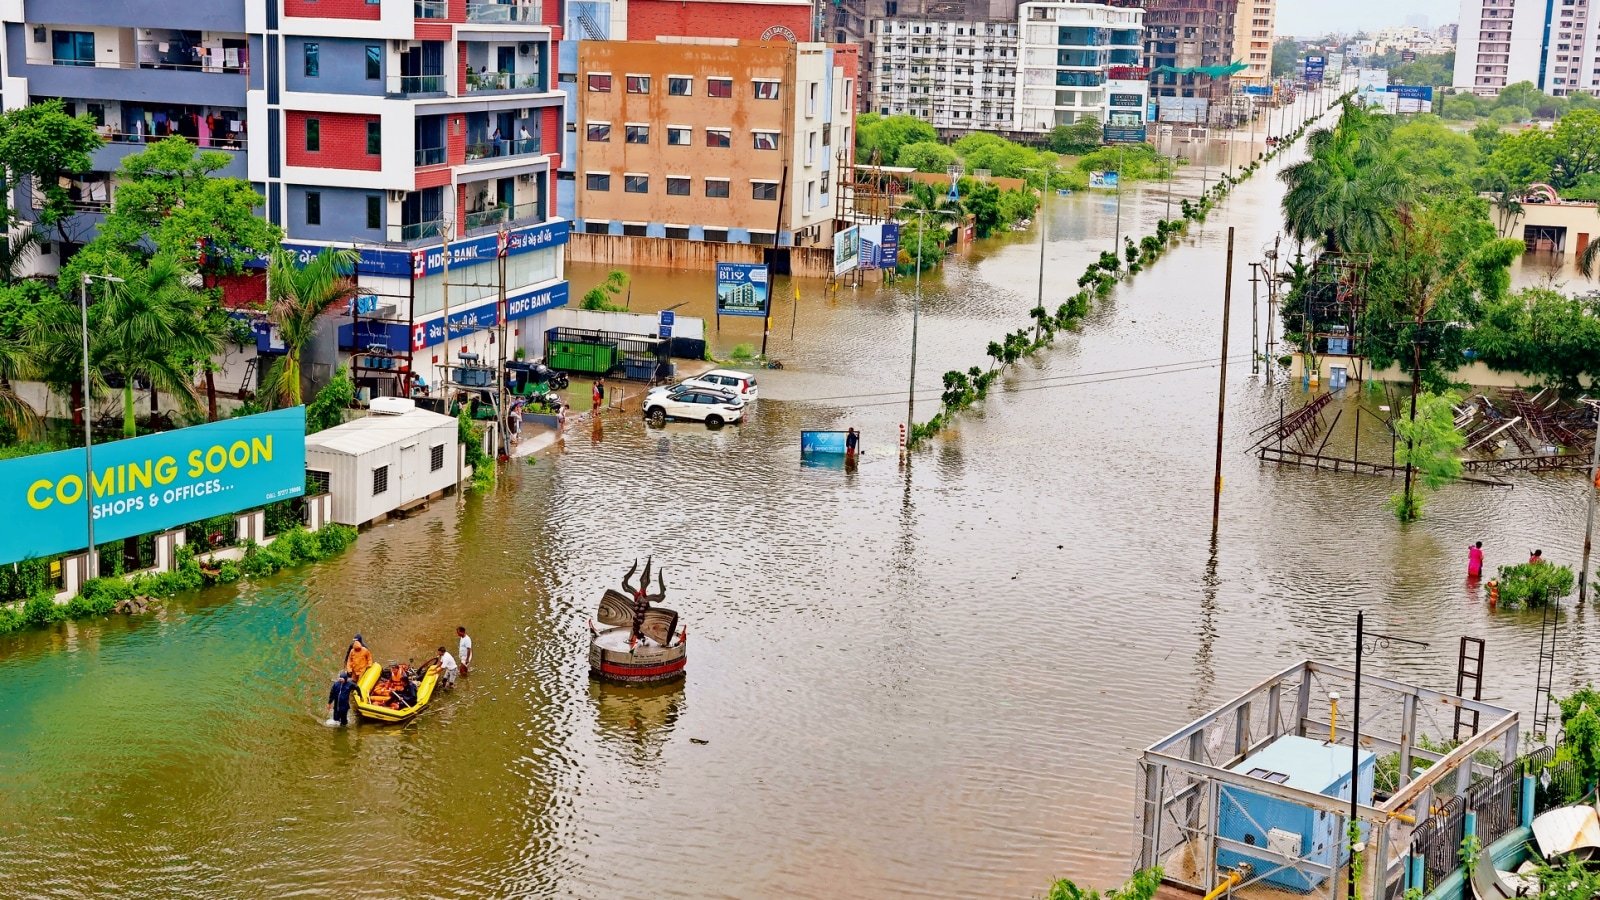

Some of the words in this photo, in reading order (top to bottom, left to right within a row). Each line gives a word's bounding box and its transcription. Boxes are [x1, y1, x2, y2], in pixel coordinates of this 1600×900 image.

[428, 251, 453, 269] HDFC
[454, 245, 478, 263] BANK
[510, 298, 530, 315] HDFC
[531, 292, 551, 309] BANK
[27, 455, 178, 510] COMING
[187, 435, 273, 478] SOON
[92, 495, 144, 520] SHOPS
[149, 493, 158, 507] &
